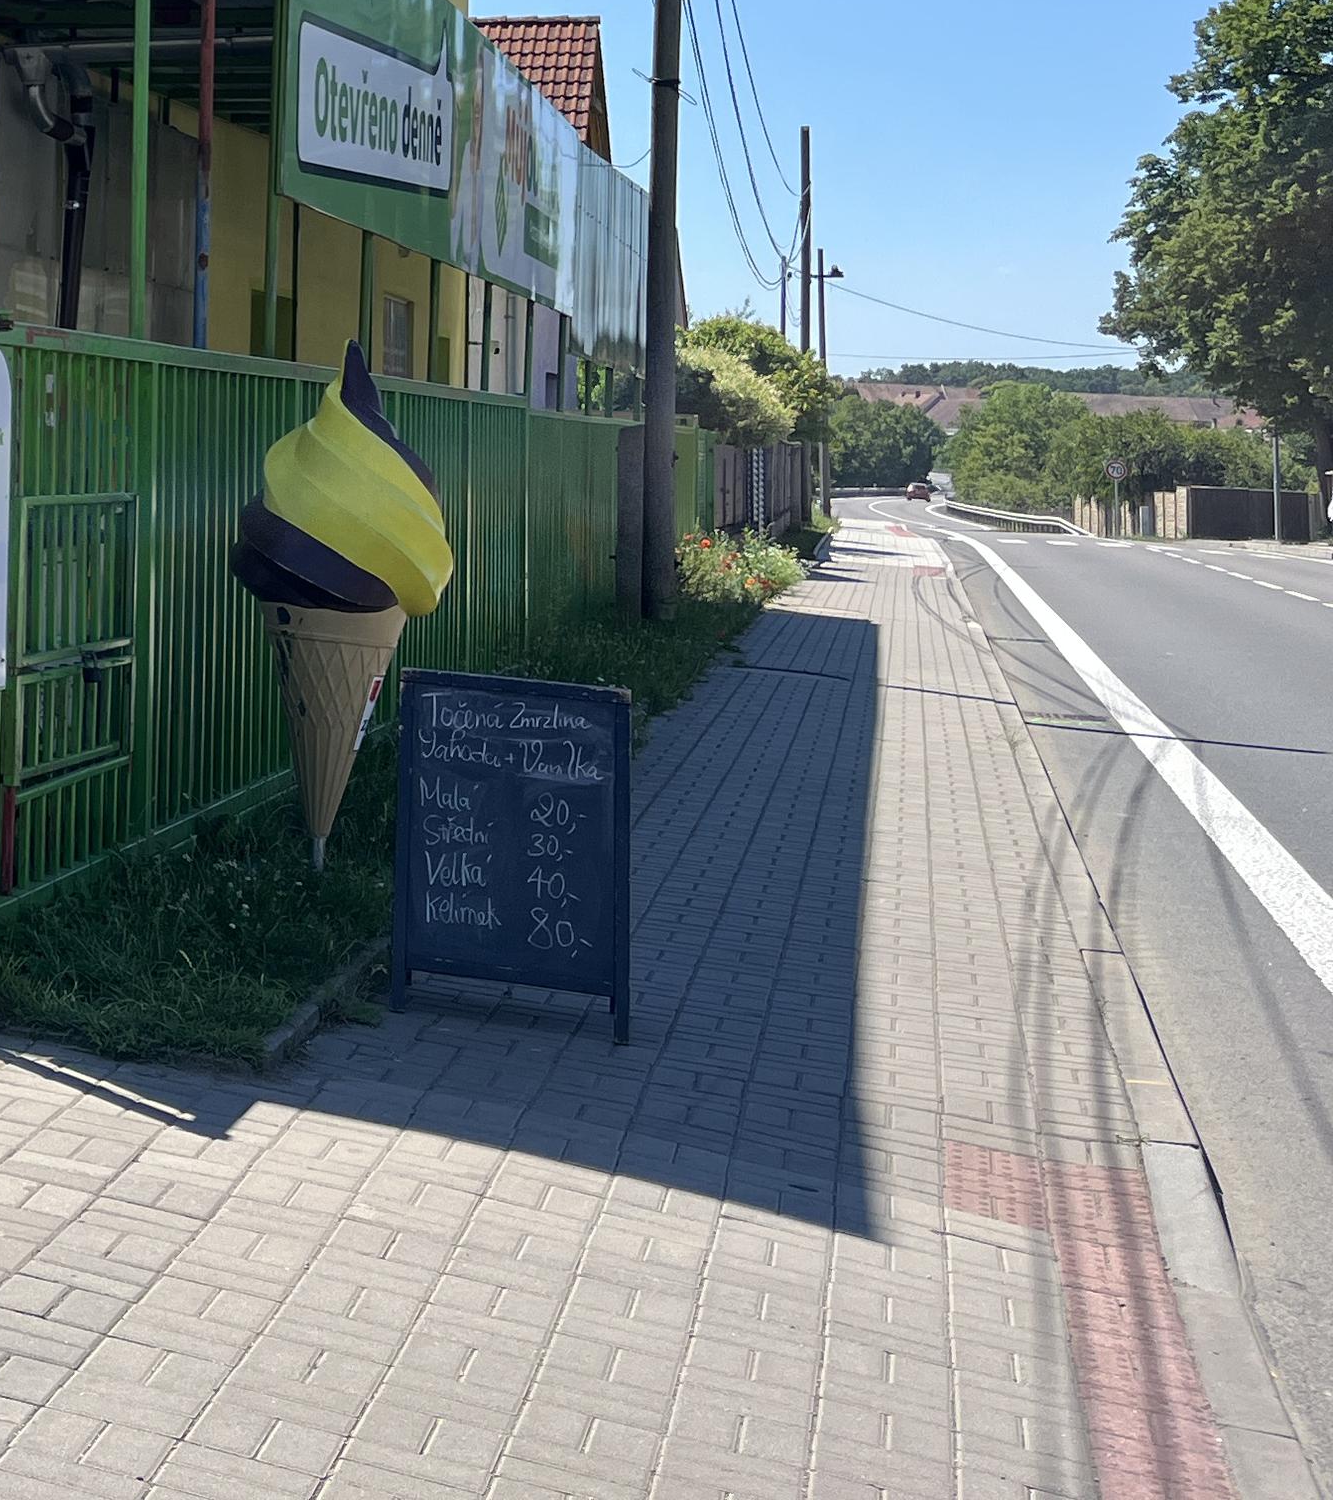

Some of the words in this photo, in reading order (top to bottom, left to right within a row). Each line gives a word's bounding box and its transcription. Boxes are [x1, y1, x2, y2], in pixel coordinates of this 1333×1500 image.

[315, 56, 398, 155] Otevřeno
[402, 86, 442, 167] denně
[1110, 465, 1123, 475] 70
[421, 693, 504, 730] Točená
[519, 740, 605, 781] Vanilka
[419, 775, 480, 812] Malá
[423, 814, 494, 846] Střední
[425, 850, 493, 888] Velká
[426, 889, 502, 930] Kelímek
